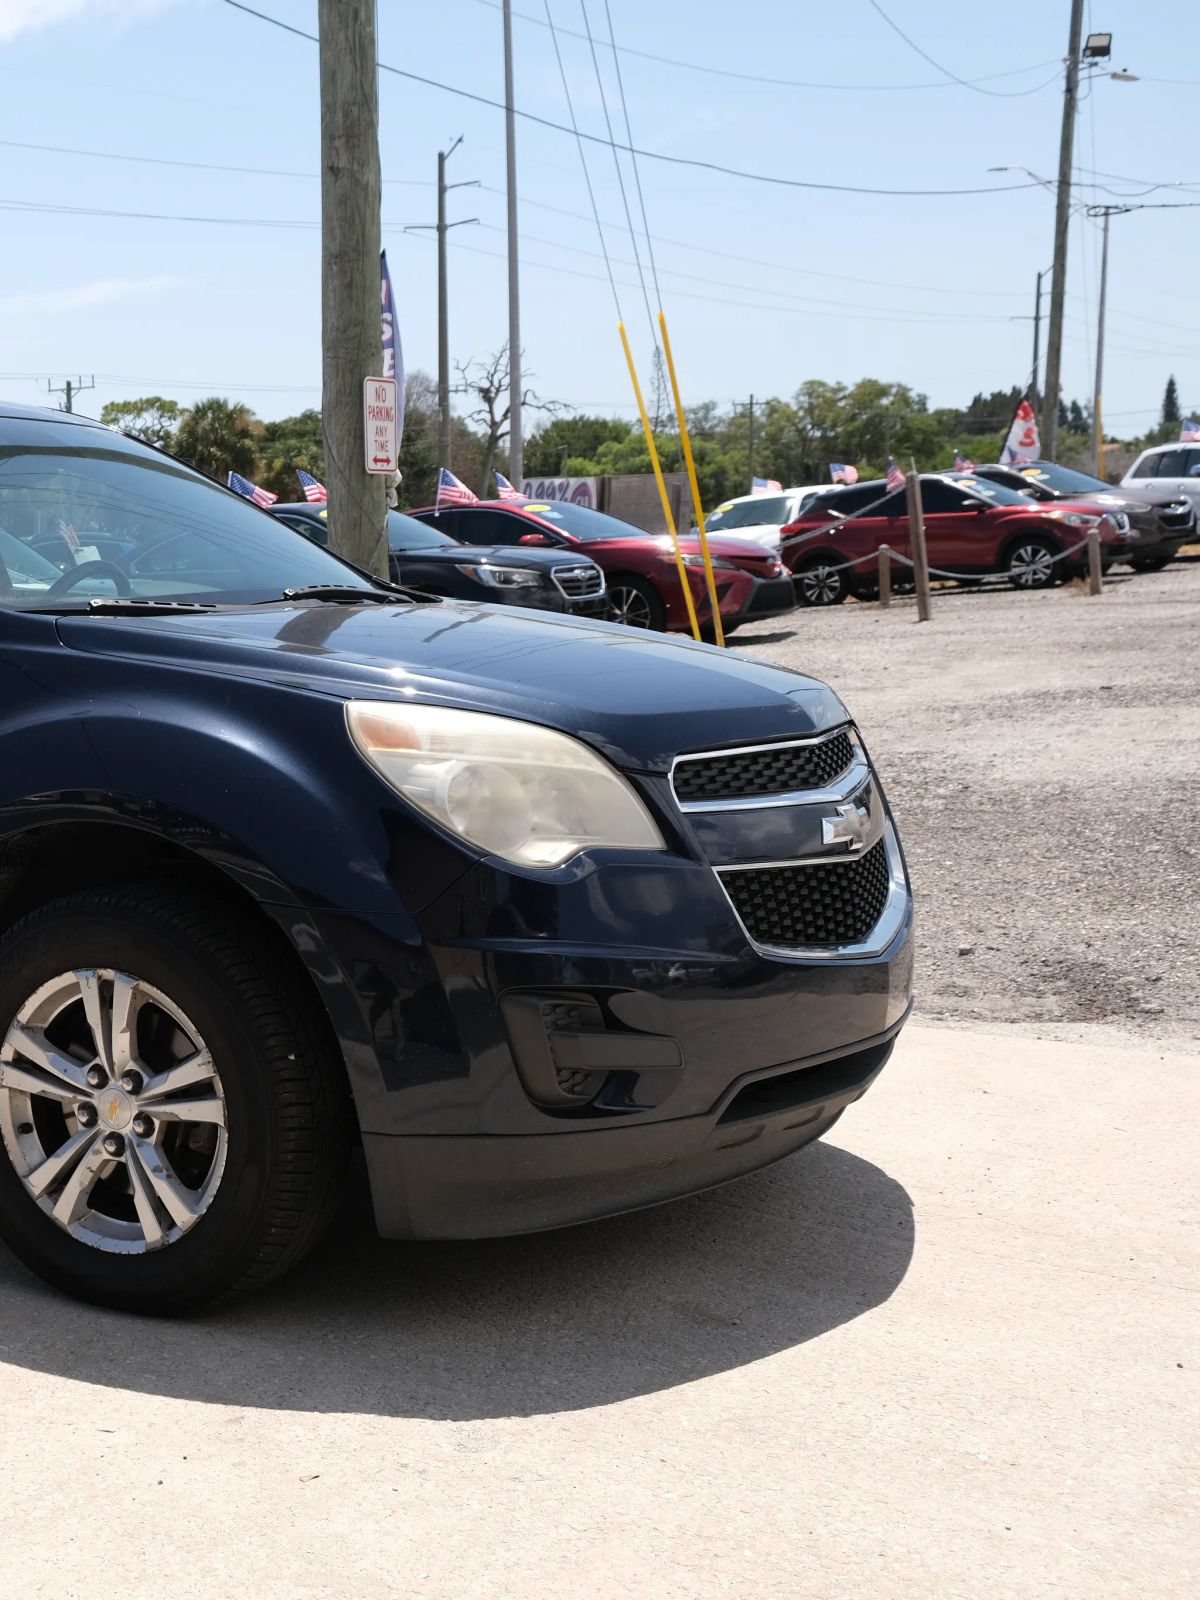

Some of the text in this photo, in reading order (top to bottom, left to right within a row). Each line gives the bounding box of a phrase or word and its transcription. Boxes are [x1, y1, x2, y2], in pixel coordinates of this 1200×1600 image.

[375, 386, 387, 403] NO
[368, 405, 394, 422] PARKING
[375, 425, 388, 438] ANY
[374, 439, 389, 453] TIME
